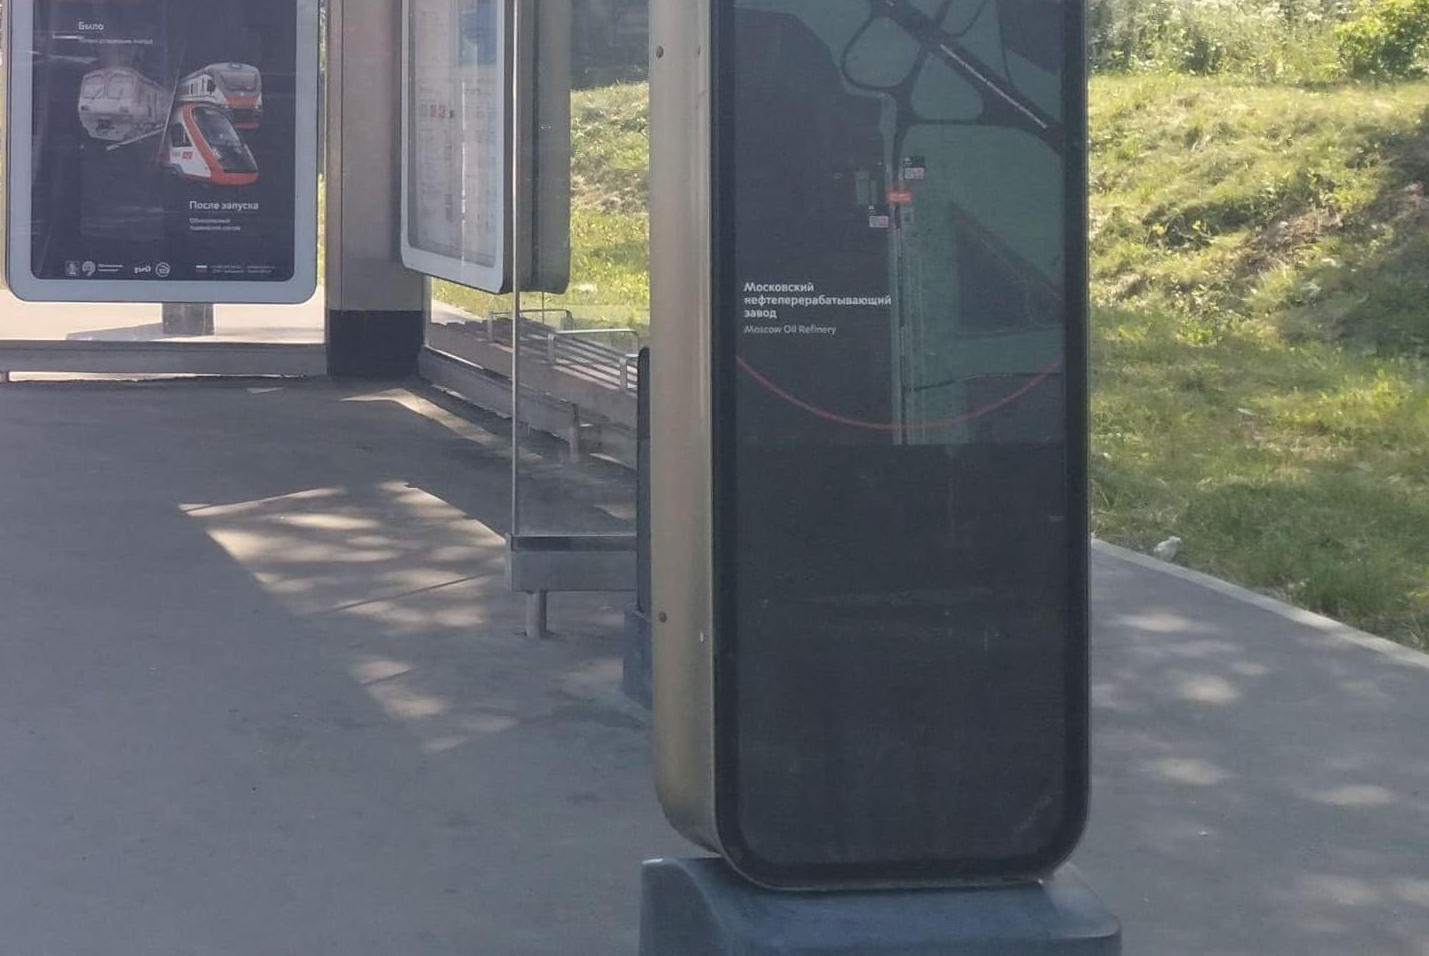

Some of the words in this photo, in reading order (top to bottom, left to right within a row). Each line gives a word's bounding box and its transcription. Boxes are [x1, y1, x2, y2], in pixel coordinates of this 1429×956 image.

[78, 21, 105, 31] Было
[189, 200, 221, 210] После
[221, 202, 259, 212] запуска
[743, 281, 815, 293] Московский
[743, 294, 892, 308] нефтеперерабатывающий
[743, 309, 778, 320] завод
[743, 324, 782, 334] Moscow
[783, 324, 797, 334] Oil
[798, 324, 837, 336] Refinery
